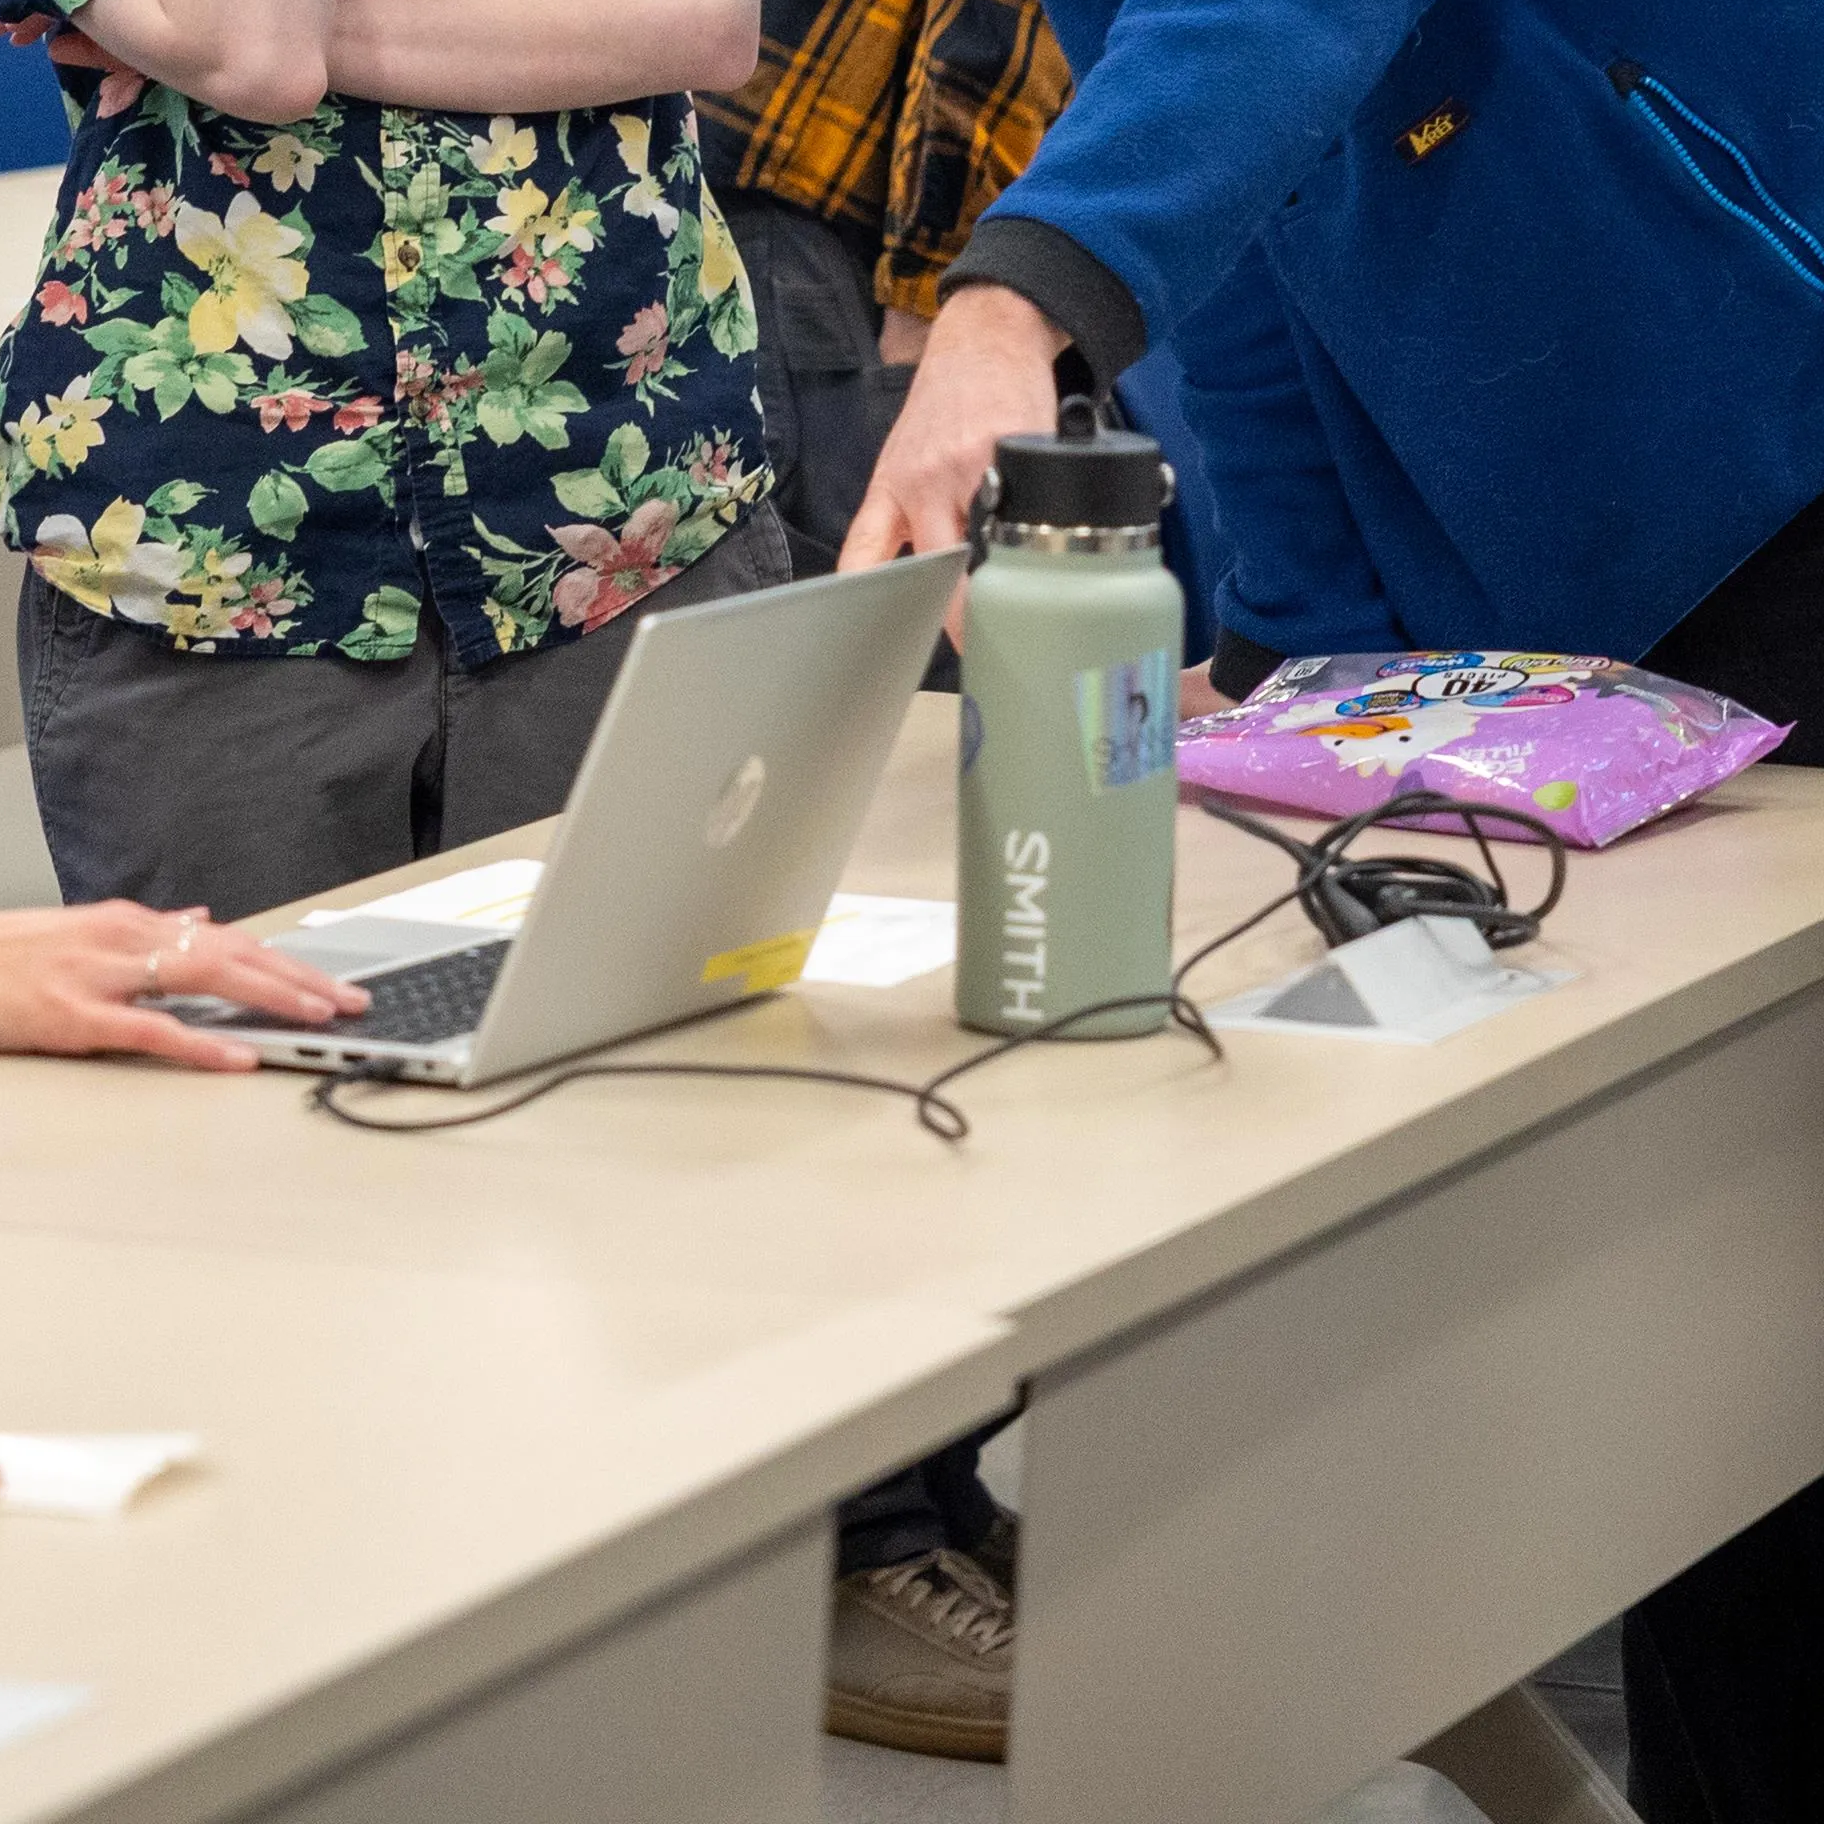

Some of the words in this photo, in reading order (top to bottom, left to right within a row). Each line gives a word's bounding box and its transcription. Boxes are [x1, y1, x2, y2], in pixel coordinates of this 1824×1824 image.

[1441, 679, 1498, 698] 40
[1458, 741, 1534, 763] FILLER
[1001, 829, 1051, 1022] SMITH
